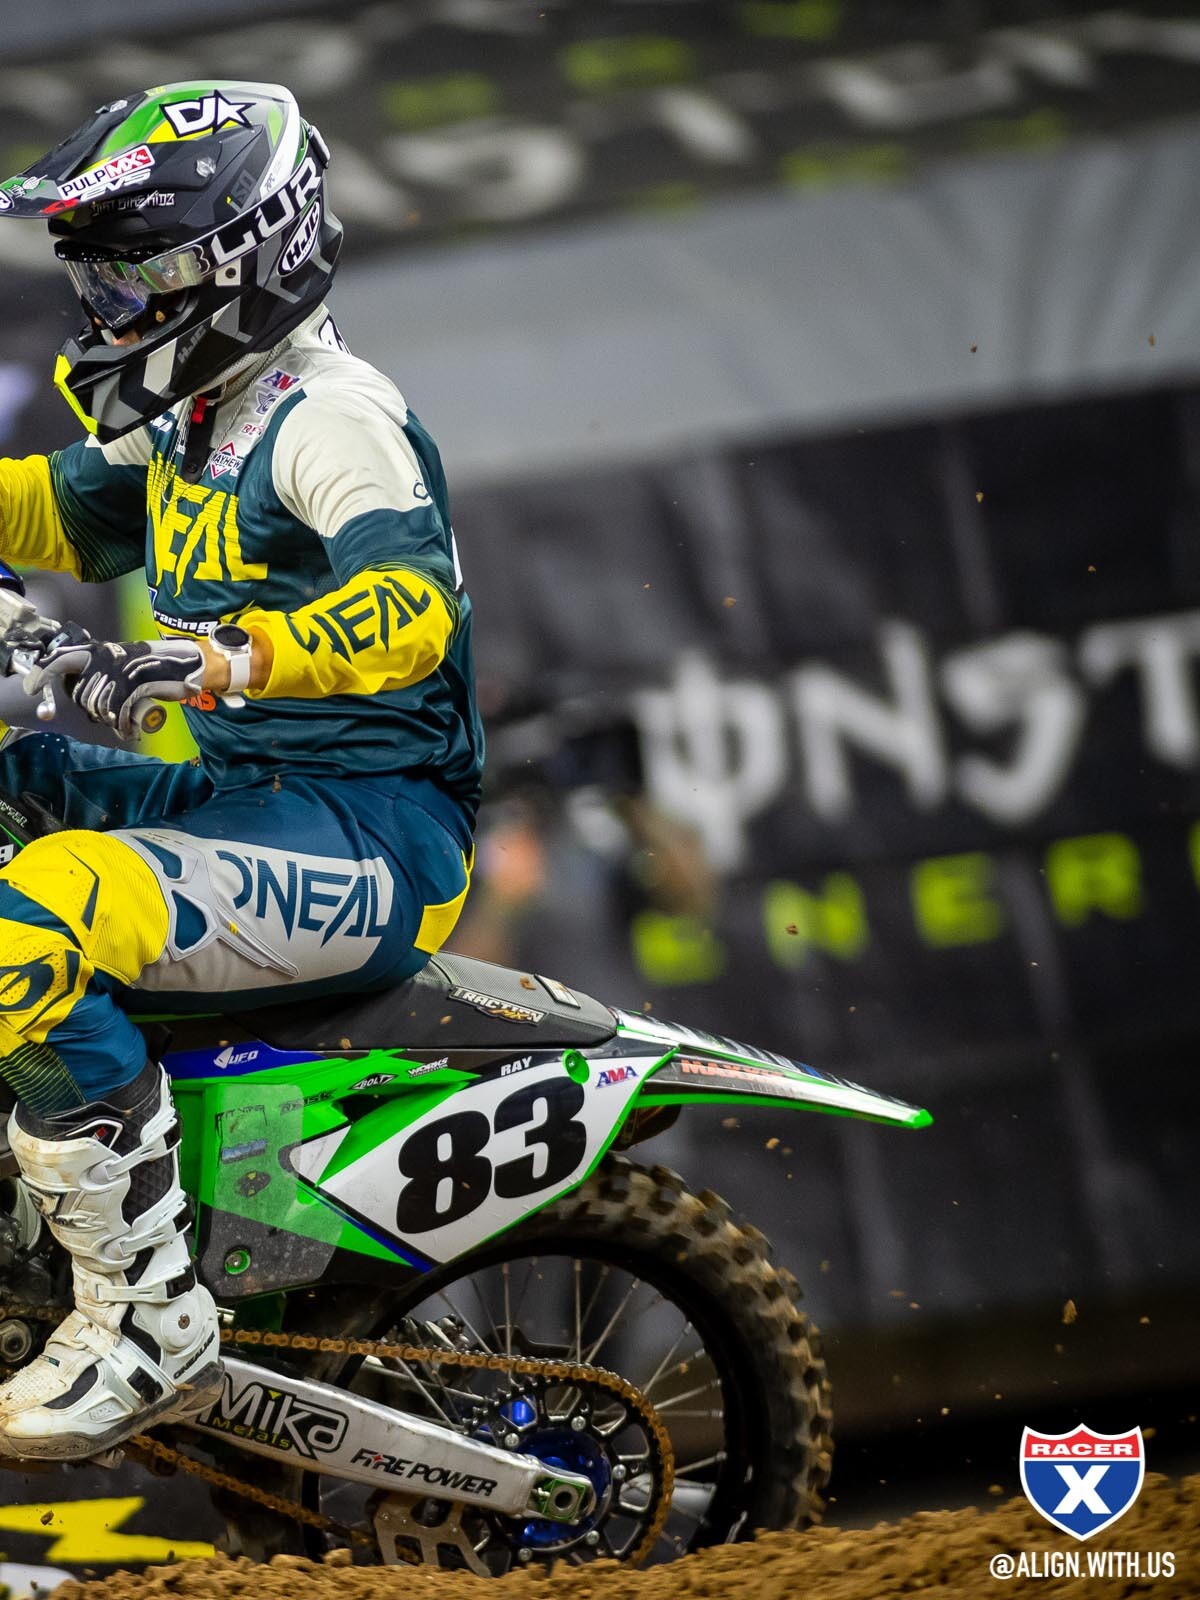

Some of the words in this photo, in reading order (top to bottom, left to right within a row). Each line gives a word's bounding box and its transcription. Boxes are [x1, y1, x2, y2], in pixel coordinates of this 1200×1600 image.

[154, 610, 218, 634] racing
[229, 1050, 259, 1065] UFO
[500, 1055, 533, 1077] RAY
[360, 1074, 386, 1088] BOLT
[595, 1065, 639, 1089] AMA
[396, 1076, 587, 1234] 83
[201, 1381, 348, 1459] Mika
[212, 1416, 291, 1449] Metals
[351, 1448, 413, 1477] FIRE
[407, 1463, 498, 1497] POWER
